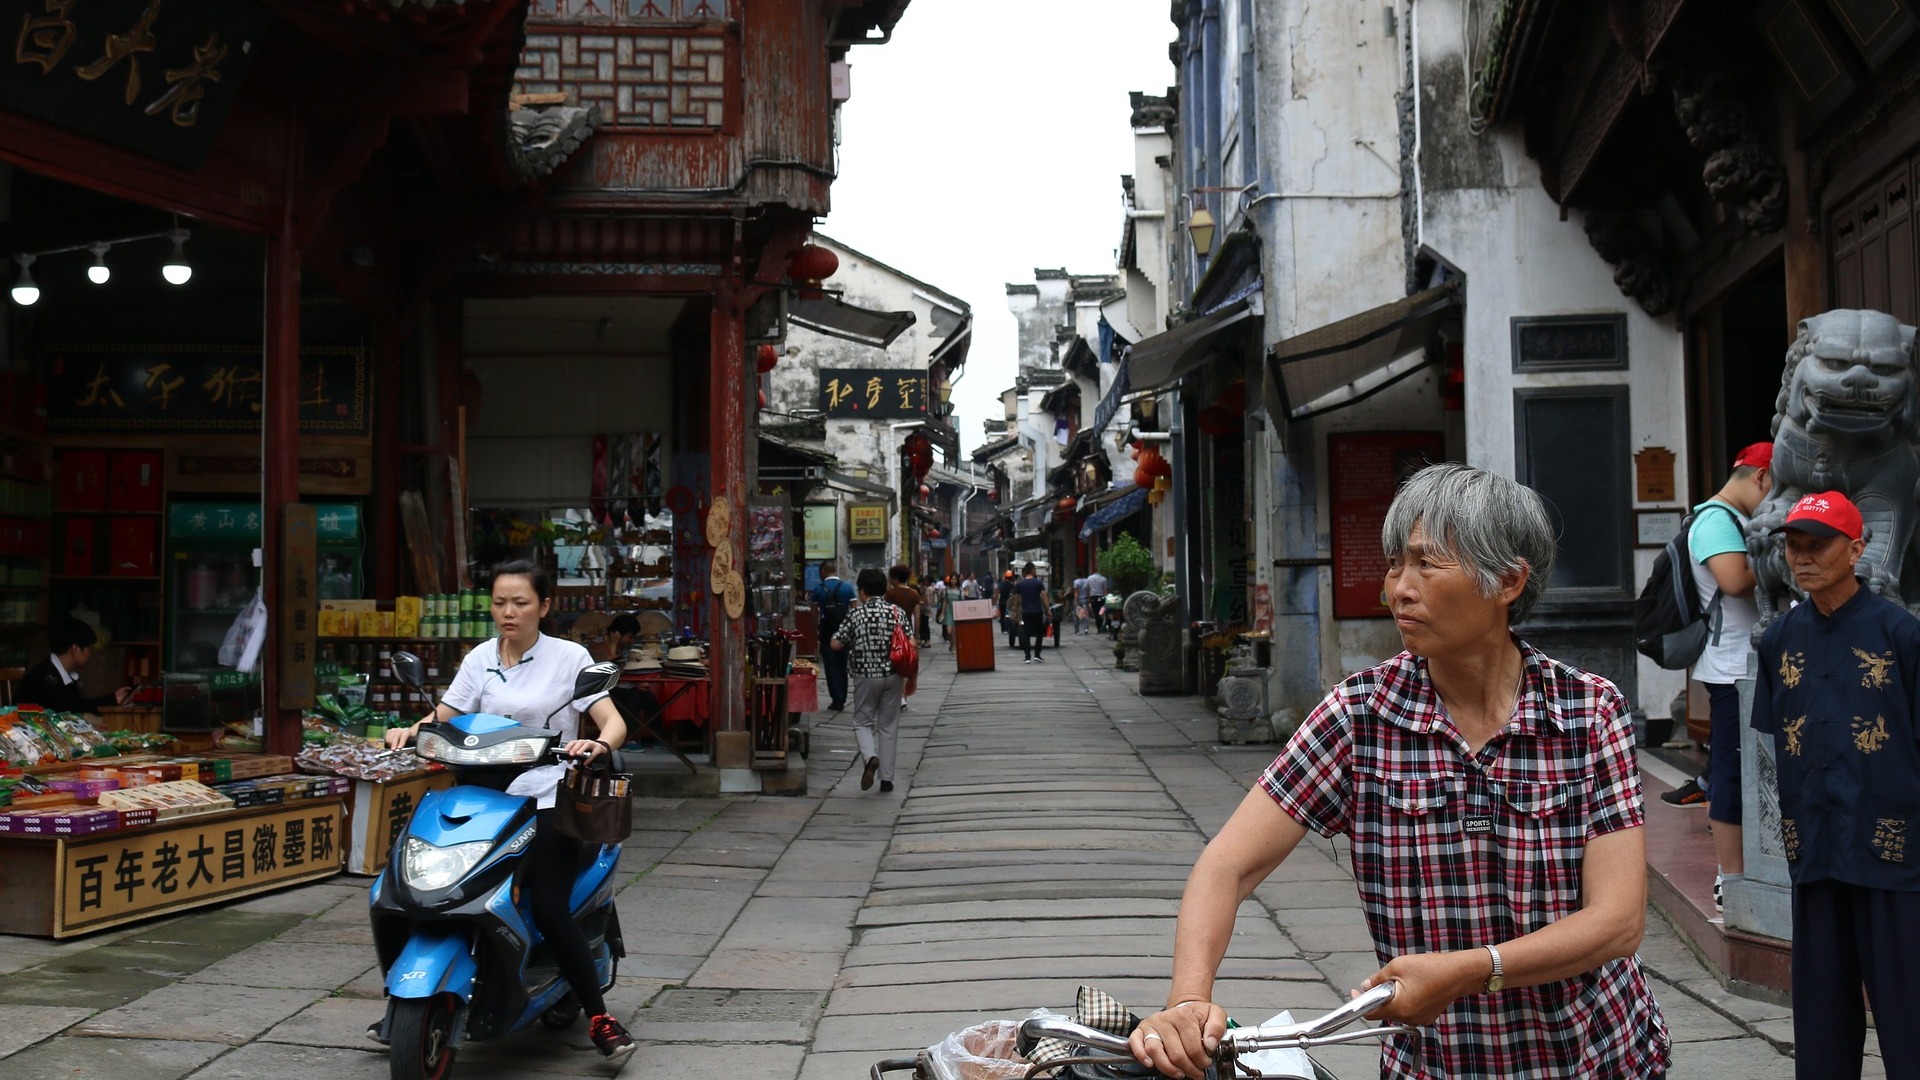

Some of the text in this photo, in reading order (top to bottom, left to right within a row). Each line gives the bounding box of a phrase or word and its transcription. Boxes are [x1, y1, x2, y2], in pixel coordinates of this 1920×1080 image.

[825, 376, 918, 411] 私房菜
[510, 827, 536, 851] SUNRA
[75, 813, 334, 912] 百年老大昌徽墨酥
